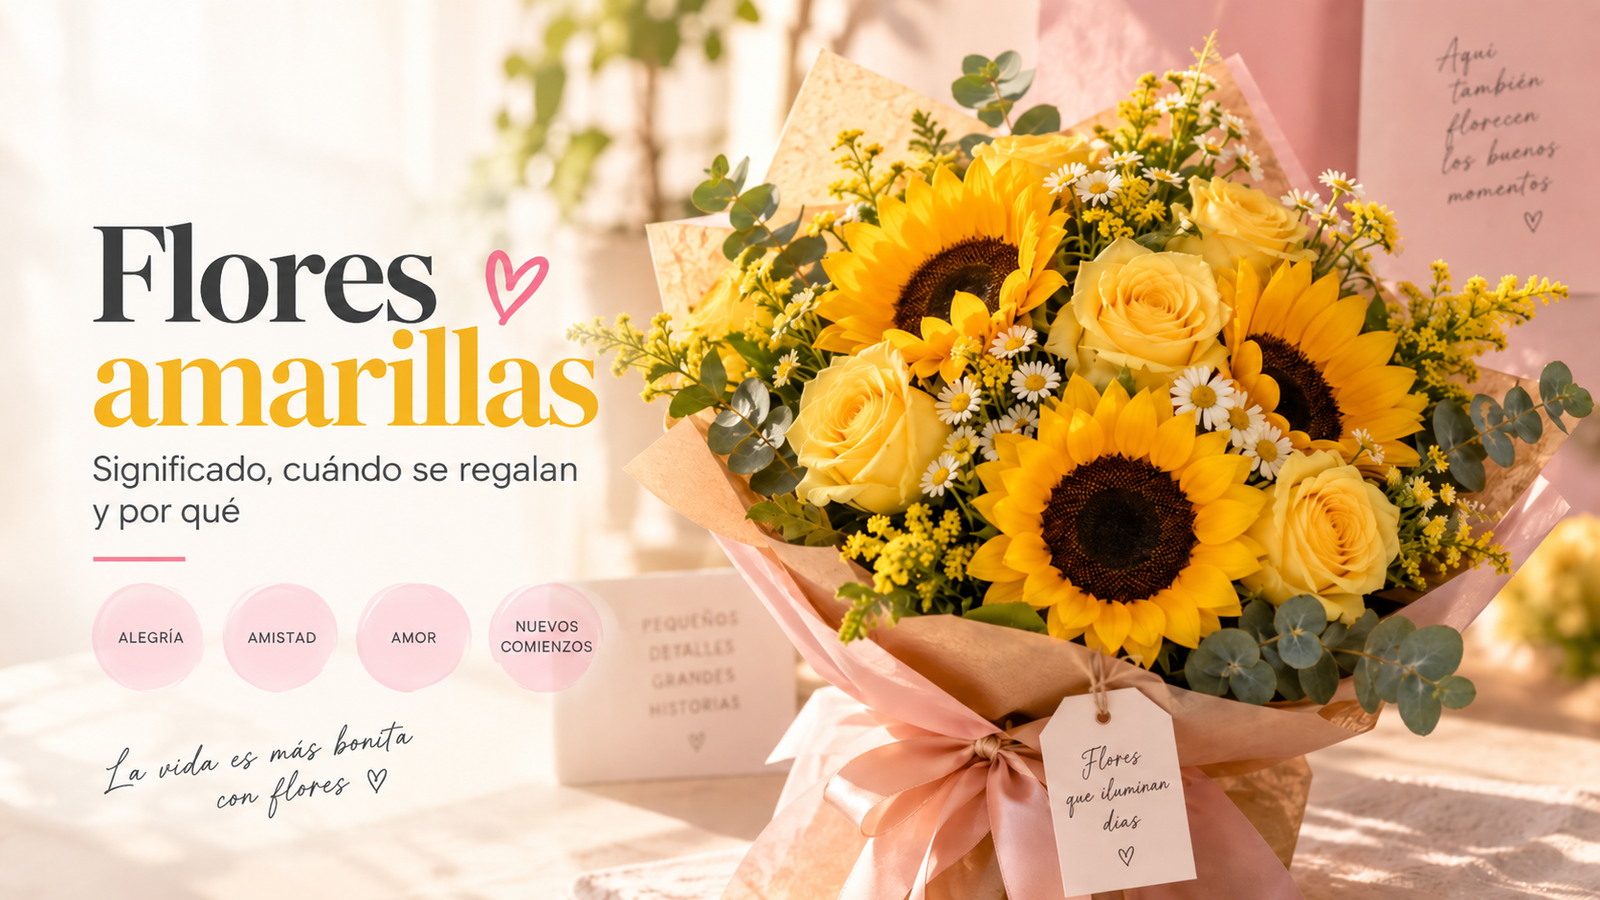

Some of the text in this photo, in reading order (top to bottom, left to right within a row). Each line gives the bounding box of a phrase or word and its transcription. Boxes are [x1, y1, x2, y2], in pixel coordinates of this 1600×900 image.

[1449, 66, 1543, 104] también
[1445, 107, 1539, 150] florecen
[1441, 138, 1559, 175] los buenos
[1447, 171, 1553, 204] momentos
[642, 609, 739, 633] PEQUEÑOS
[649, 638, 735, 662] DETALLES
[651, 667, 736, 690] GRANDES
[649, 695, 741, 717] HISTORIAS
[1081, 745, 1141, 780] Flores
[1066, 777, 1170, 818] que iluminan
